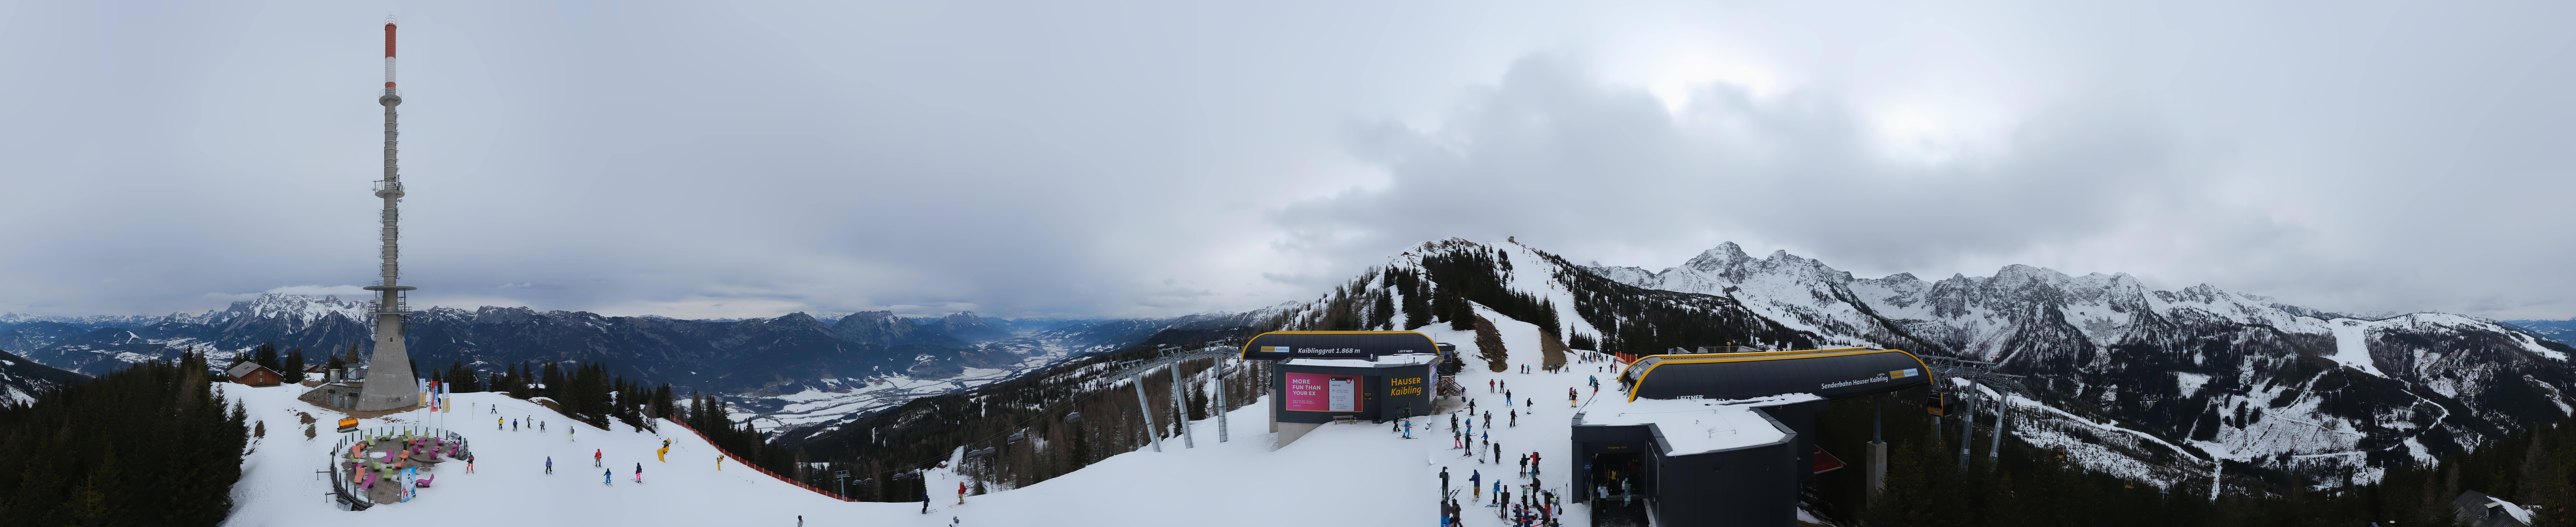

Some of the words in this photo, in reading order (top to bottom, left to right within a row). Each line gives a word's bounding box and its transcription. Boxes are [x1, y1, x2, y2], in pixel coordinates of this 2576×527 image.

[1391, 377, 1421, 386] HAUSER
[1821, 380, 1852, 389] Senderbahn
[1391, 386, 1421, 396] Kaibling
